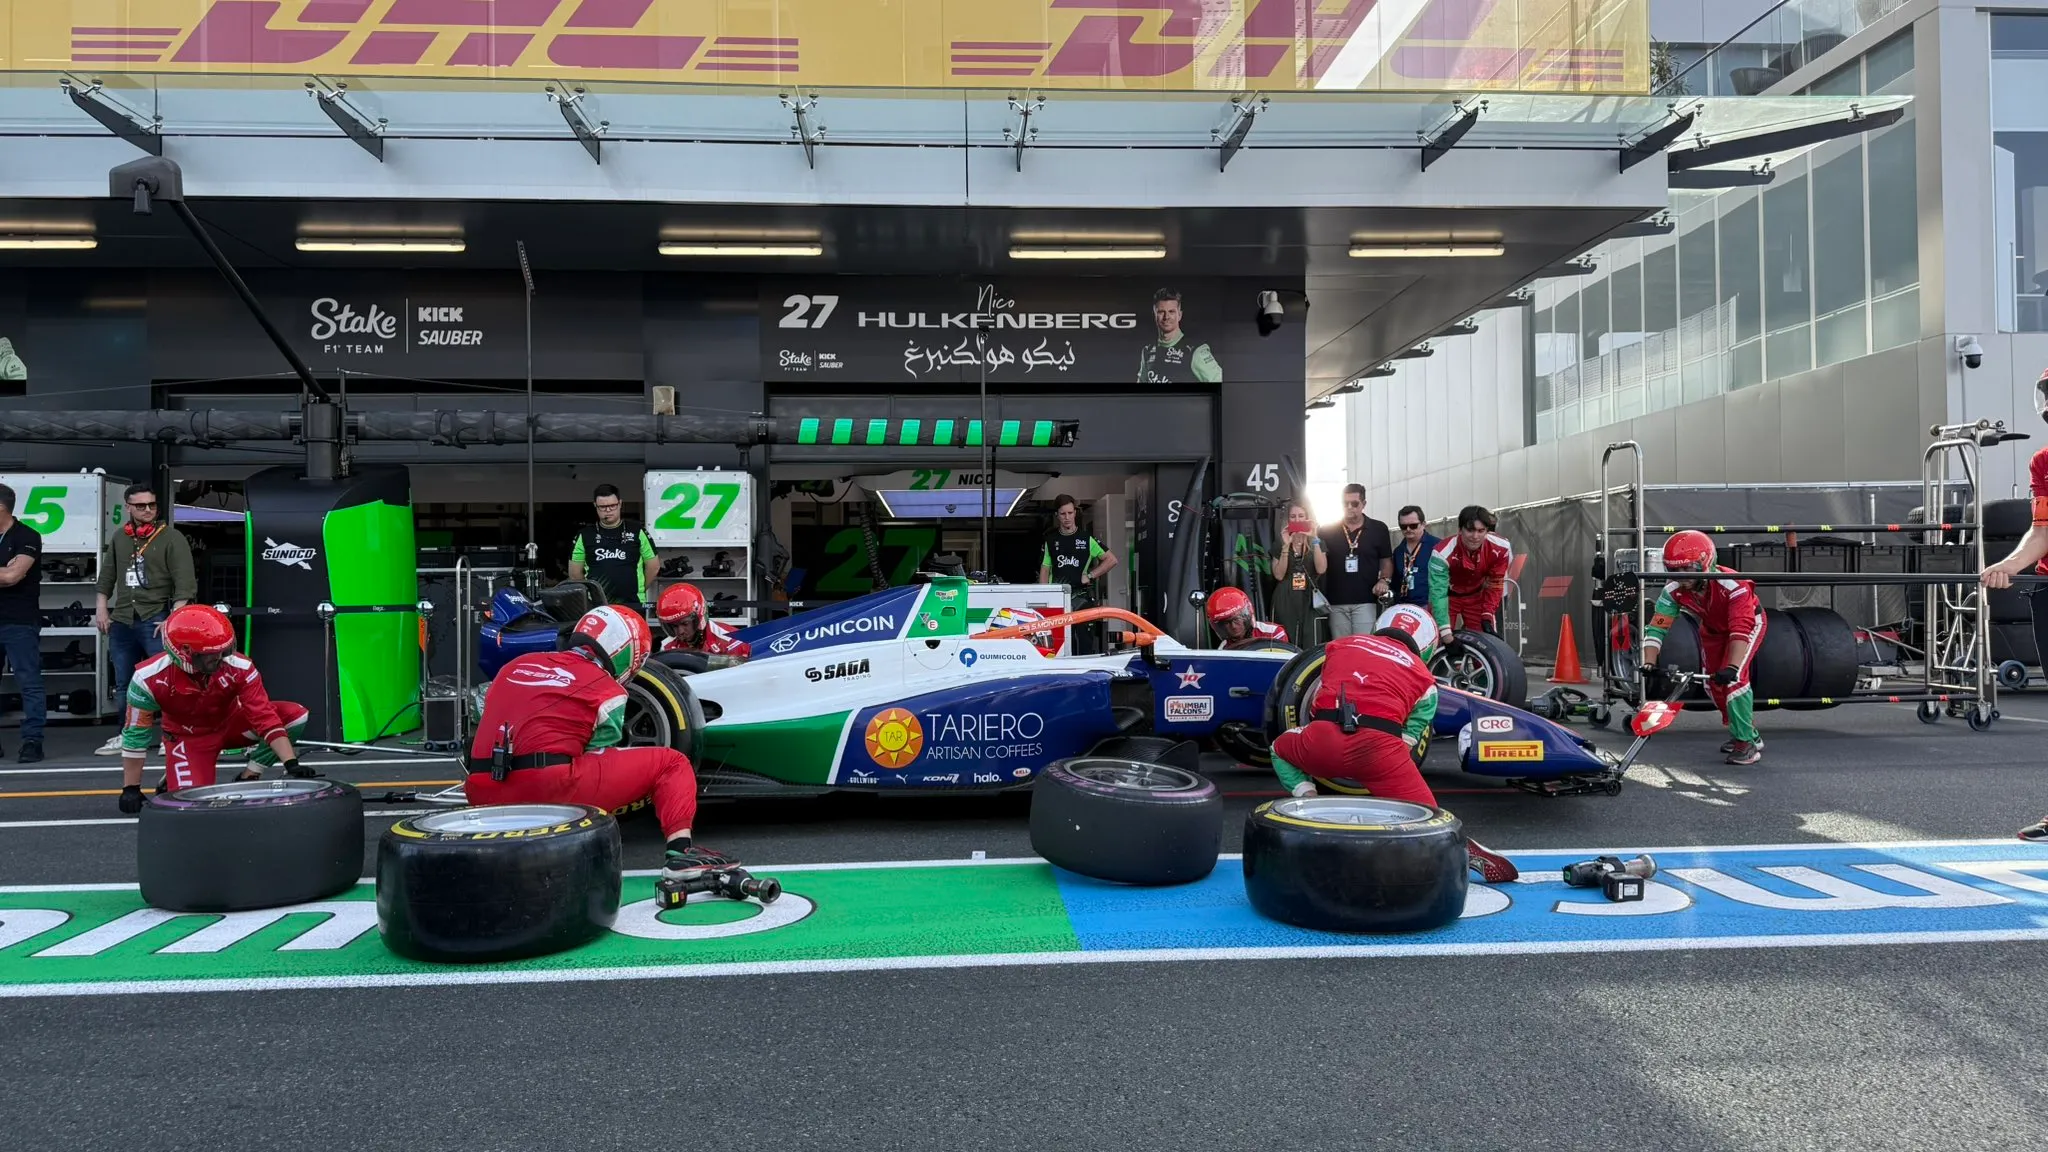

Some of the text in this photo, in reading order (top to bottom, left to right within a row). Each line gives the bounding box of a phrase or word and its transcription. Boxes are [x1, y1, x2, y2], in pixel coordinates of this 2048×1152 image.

[976, 284, 1016, 319] Nico
[311, 297, 397, 340] Stake
[418, 307, 463, 322] KICK
[779, 294, 839, 329] 27
[858, 312, 1137, 329] HULKENBERG
[418, 330, 483, 345] SAUBER
[346, 345, 384, 354] TEAM
[779, 349, 812, 367] Stake
[819, 353, 836, 361] KICK
[1021, 336, 1076, 374] نيكو
[819, 361, 843, 369] SAUBER
[909, 469, 951, 490] 27
[1246, 463, 1280, 492] 45
[19, 486, 68, 534] 5
[112, 504, 122, 525] 5
[654, 482, 741, 530] 27
[264, 549, 315, 560] SUNOCO
[594, 548, 626, 561] Stake
[816, 528, 936, 592] 27
[1057, 554, 1080, 568] Stake
[805, 615, 894, 641] UNICOIN
[512, 668, 571, 684] PREMA
[824, 658, 870, 681] SAGA
[1170, 701, 1207, 709] MUMBAI
[926, 712, 1044, 742] TARIERO
[1480, 719, 1511, 729] CRC
[884, 731, 903, 743] TAR
[926, 742, 1042, 760] ARTISAN COFFEES
[1484, 744, 1539, 758] PIRELLI
[973, 772, 1003, 784] halo.
[472, 822, 573, 840] ZERO
